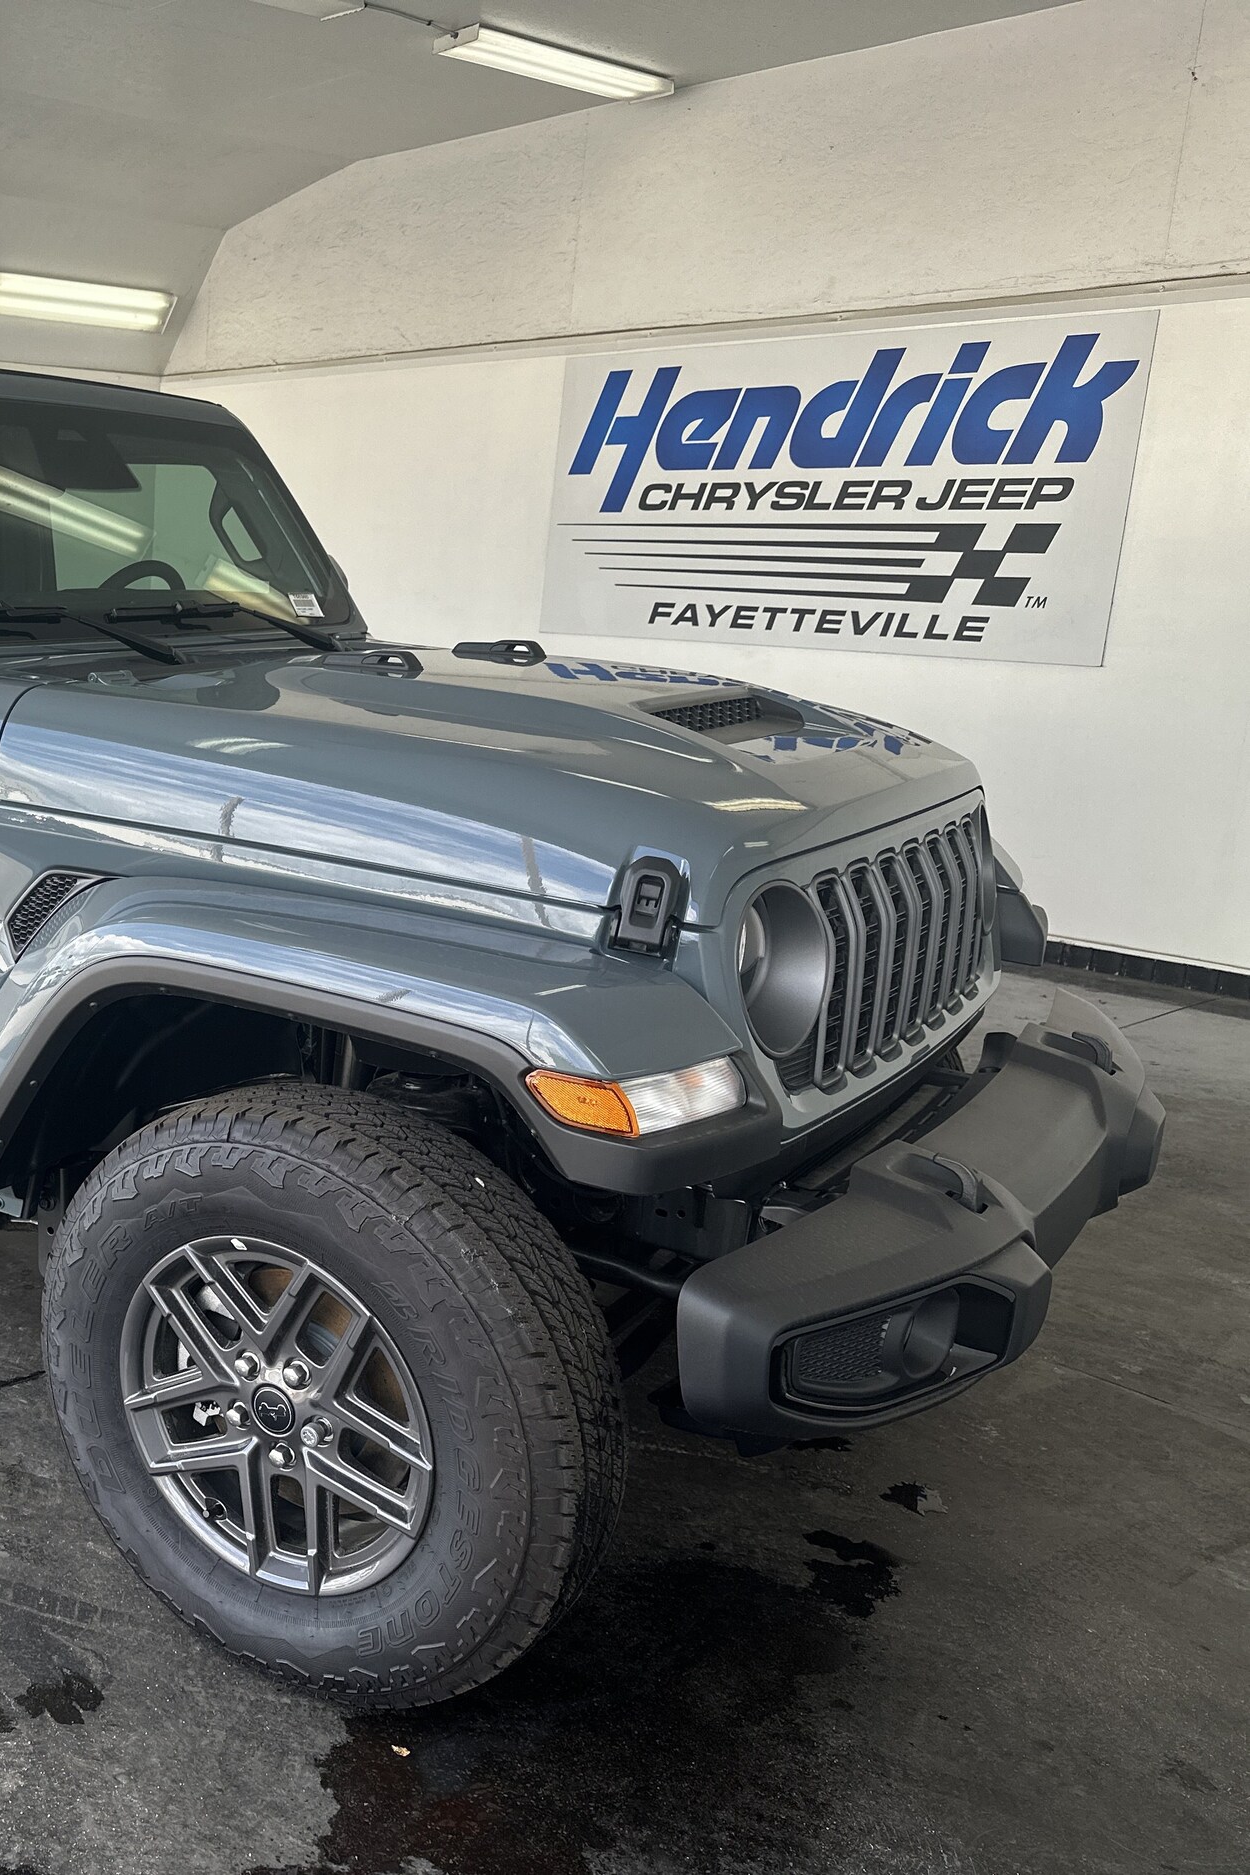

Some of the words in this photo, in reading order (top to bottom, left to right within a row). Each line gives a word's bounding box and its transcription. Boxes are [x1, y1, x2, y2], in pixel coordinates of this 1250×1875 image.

[568, 333, 1140, 513] Hendrick
[638, 479, 912, 512] CHRYSLER
[915, 476, 1075, 511] JEEP
[647, 601, 990, 643] FAYETTEVILLE
[143, 1192, 205, 1232] A/T
[356, 1280, 484, 1658] BRIDGESTONE
